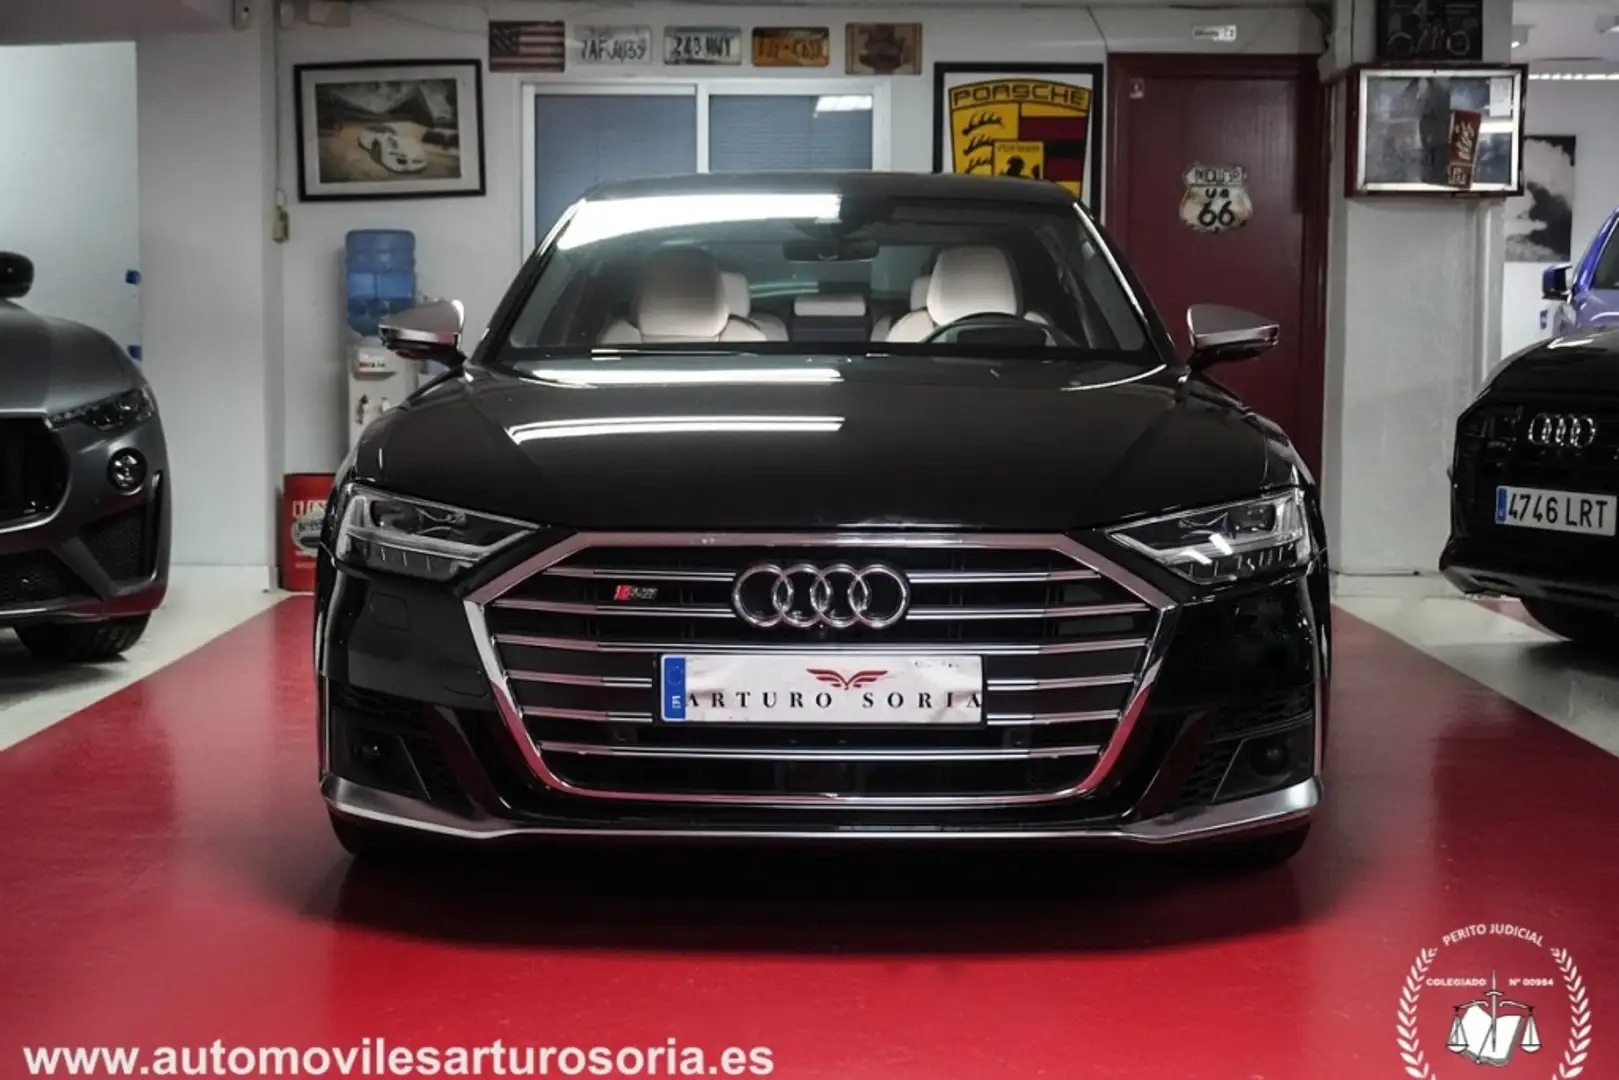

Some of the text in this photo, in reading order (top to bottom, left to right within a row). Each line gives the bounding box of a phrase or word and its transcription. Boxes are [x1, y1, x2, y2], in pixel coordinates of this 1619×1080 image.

[953, 84, 1086, 106] PORSCHE
[1198, 200, 1236, 226] 66
[1507, 493, 1609, 528] 4746 LRT
[686, 691, 983, 708] ARTURO SORIA
